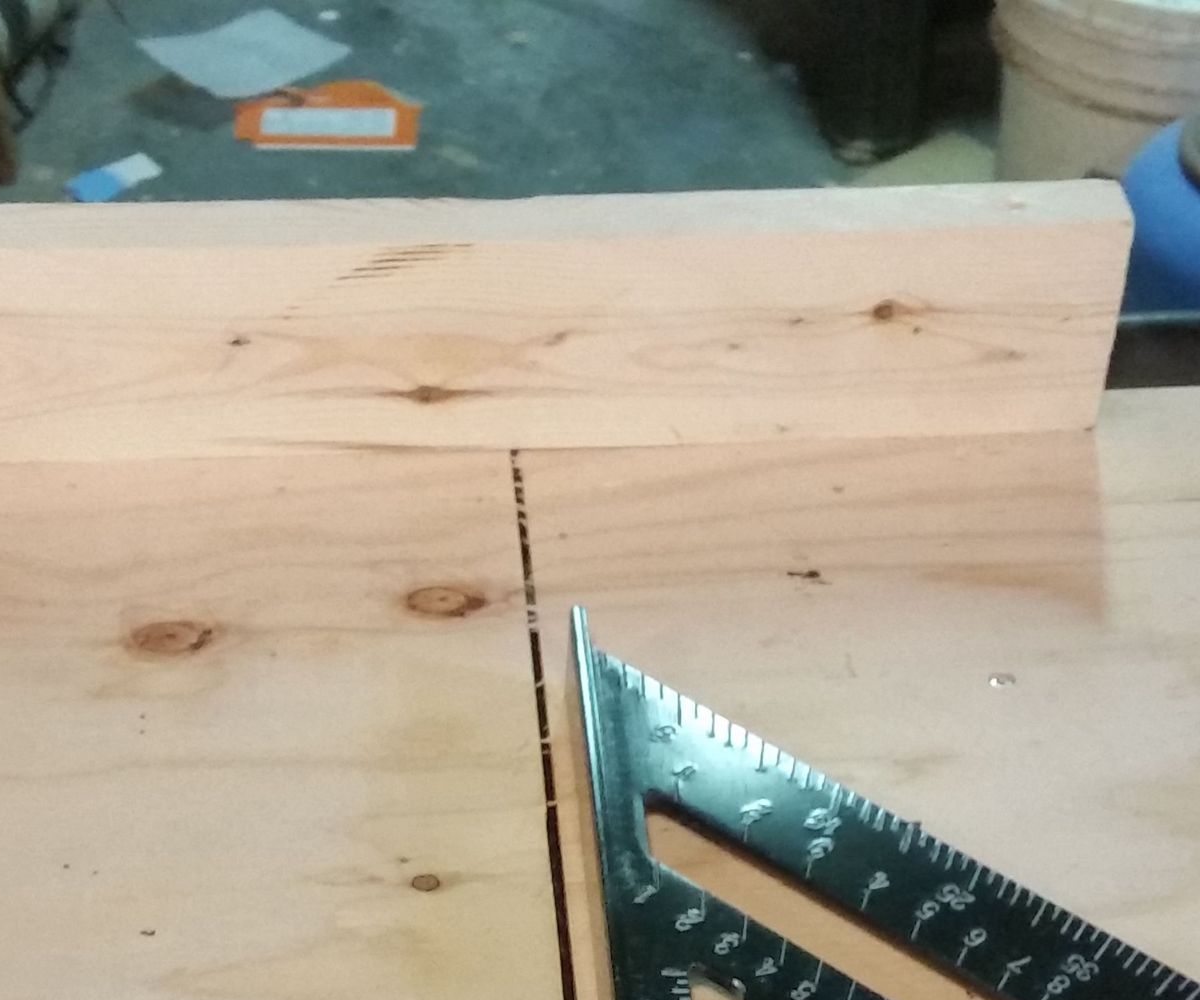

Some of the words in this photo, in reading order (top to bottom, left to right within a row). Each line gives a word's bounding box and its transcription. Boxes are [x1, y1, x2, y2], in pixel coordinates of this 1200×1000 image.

[755, 957, 779, 977] 4
[915, 901, 940, 920] 5
[963, 927, 988, 947] 6
[1006, 955, 1033, 975] 7
[1046, 974, 1071, 994] 8
[935, 884, 976, 911] 25
[1061, 953, 1100, 981] 35
